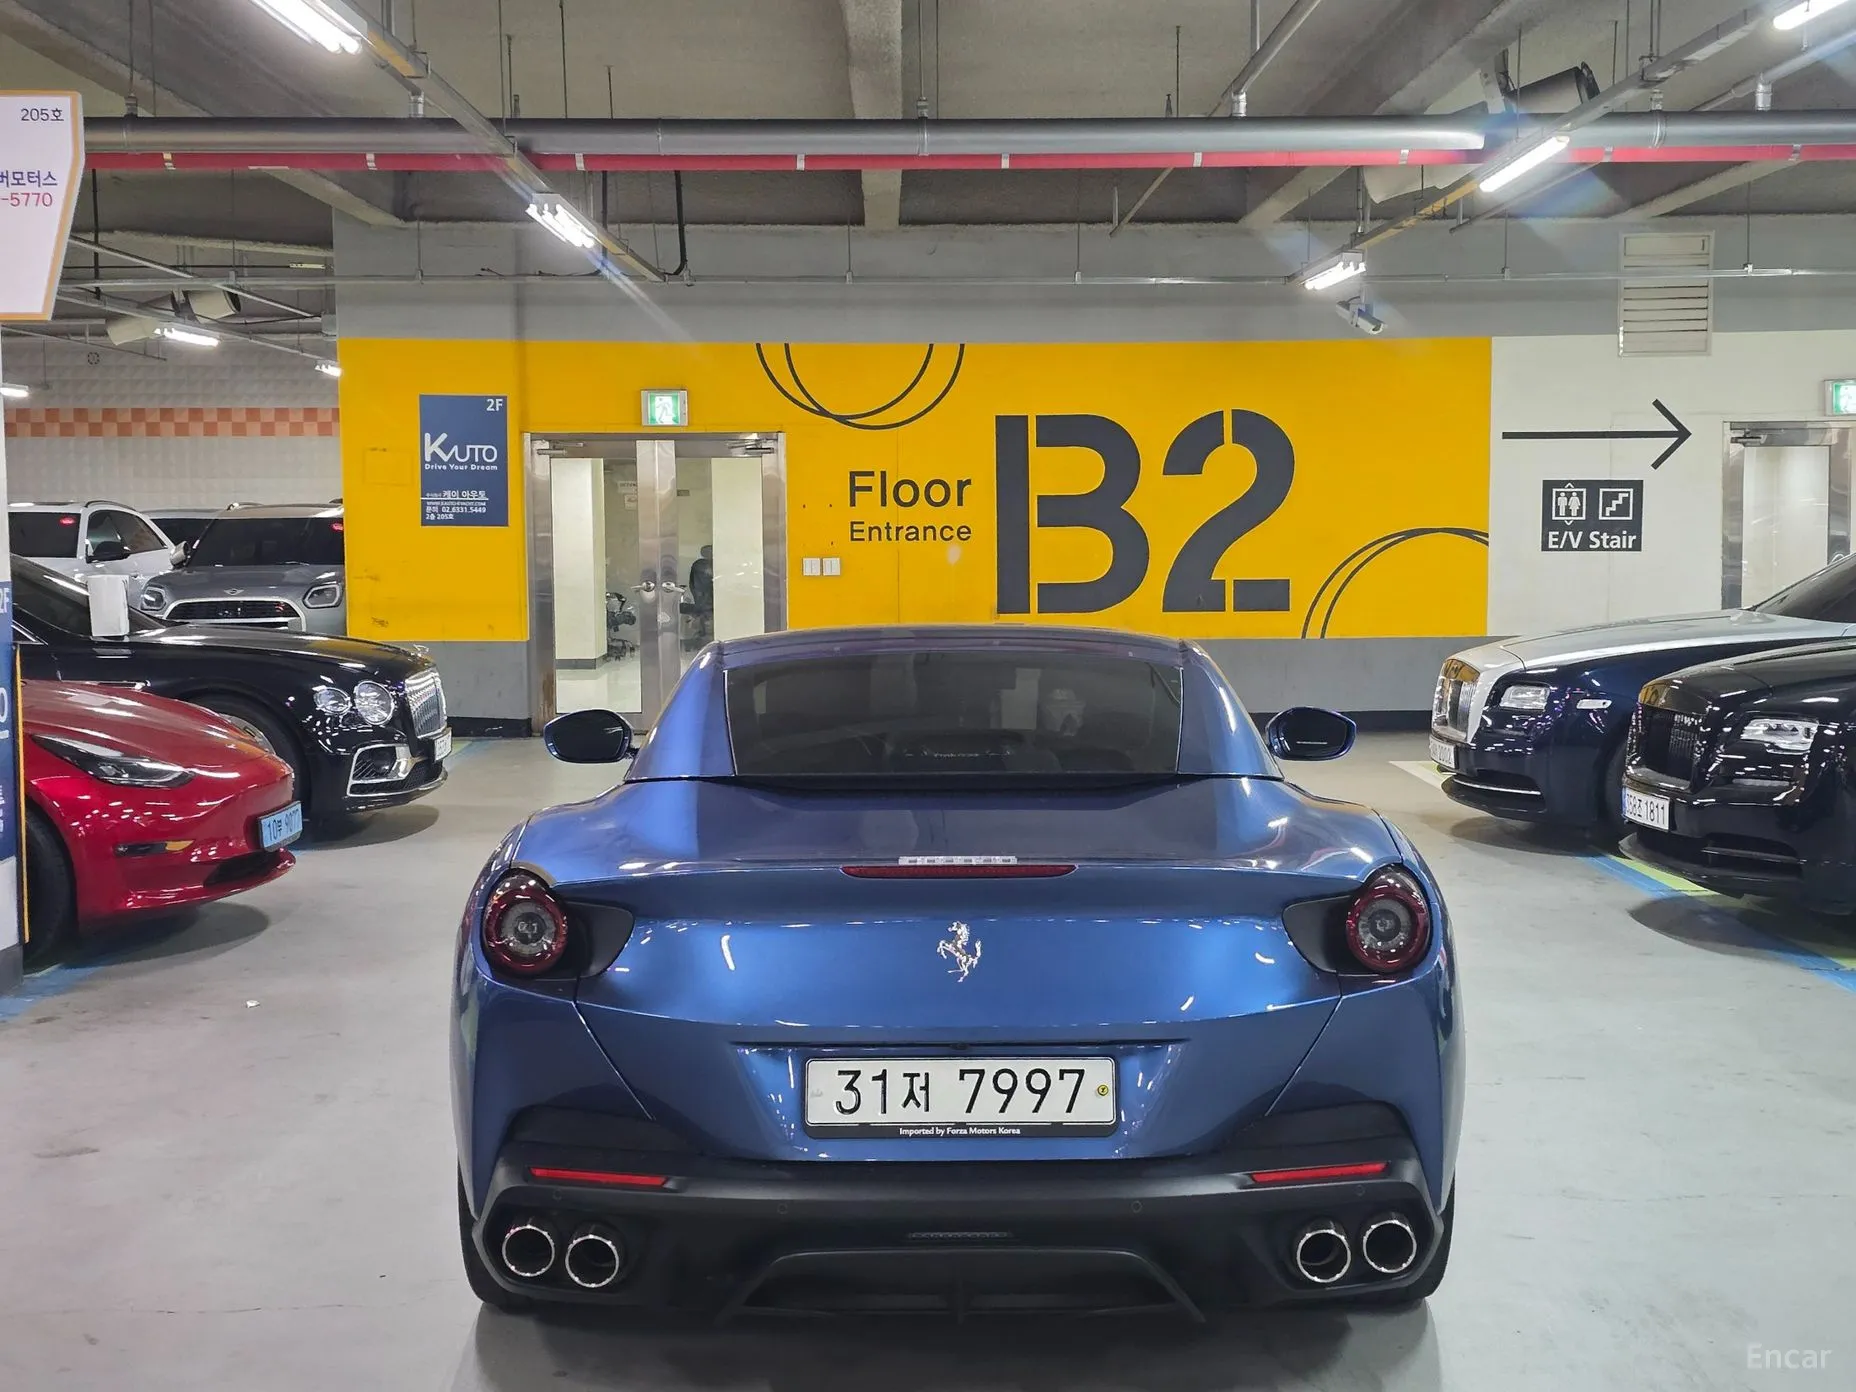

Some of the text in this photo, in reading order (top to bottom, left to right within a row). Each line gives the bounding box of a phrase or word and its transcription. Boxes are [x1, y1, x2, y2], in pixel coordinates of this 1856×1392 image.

[20, 107, 65, 122] 205호
[486, 398, 503, 411] 2F
[424, 463, 447, 471] Drive
[449, 463, 468, 471] Your
[849, 470, 972, 508] Floor
[995, 409, 1295, 614] B2
[850, 521, 972, 542] Entrance
[1548, 530, 1637, 549] E/V Stair
[1644, 800, 1665, 825] 1811
[835, 1068, 1086, 1115] 31저 7997
[899, 1127, 1021, 1137] Imported by Forza Motors Korea
